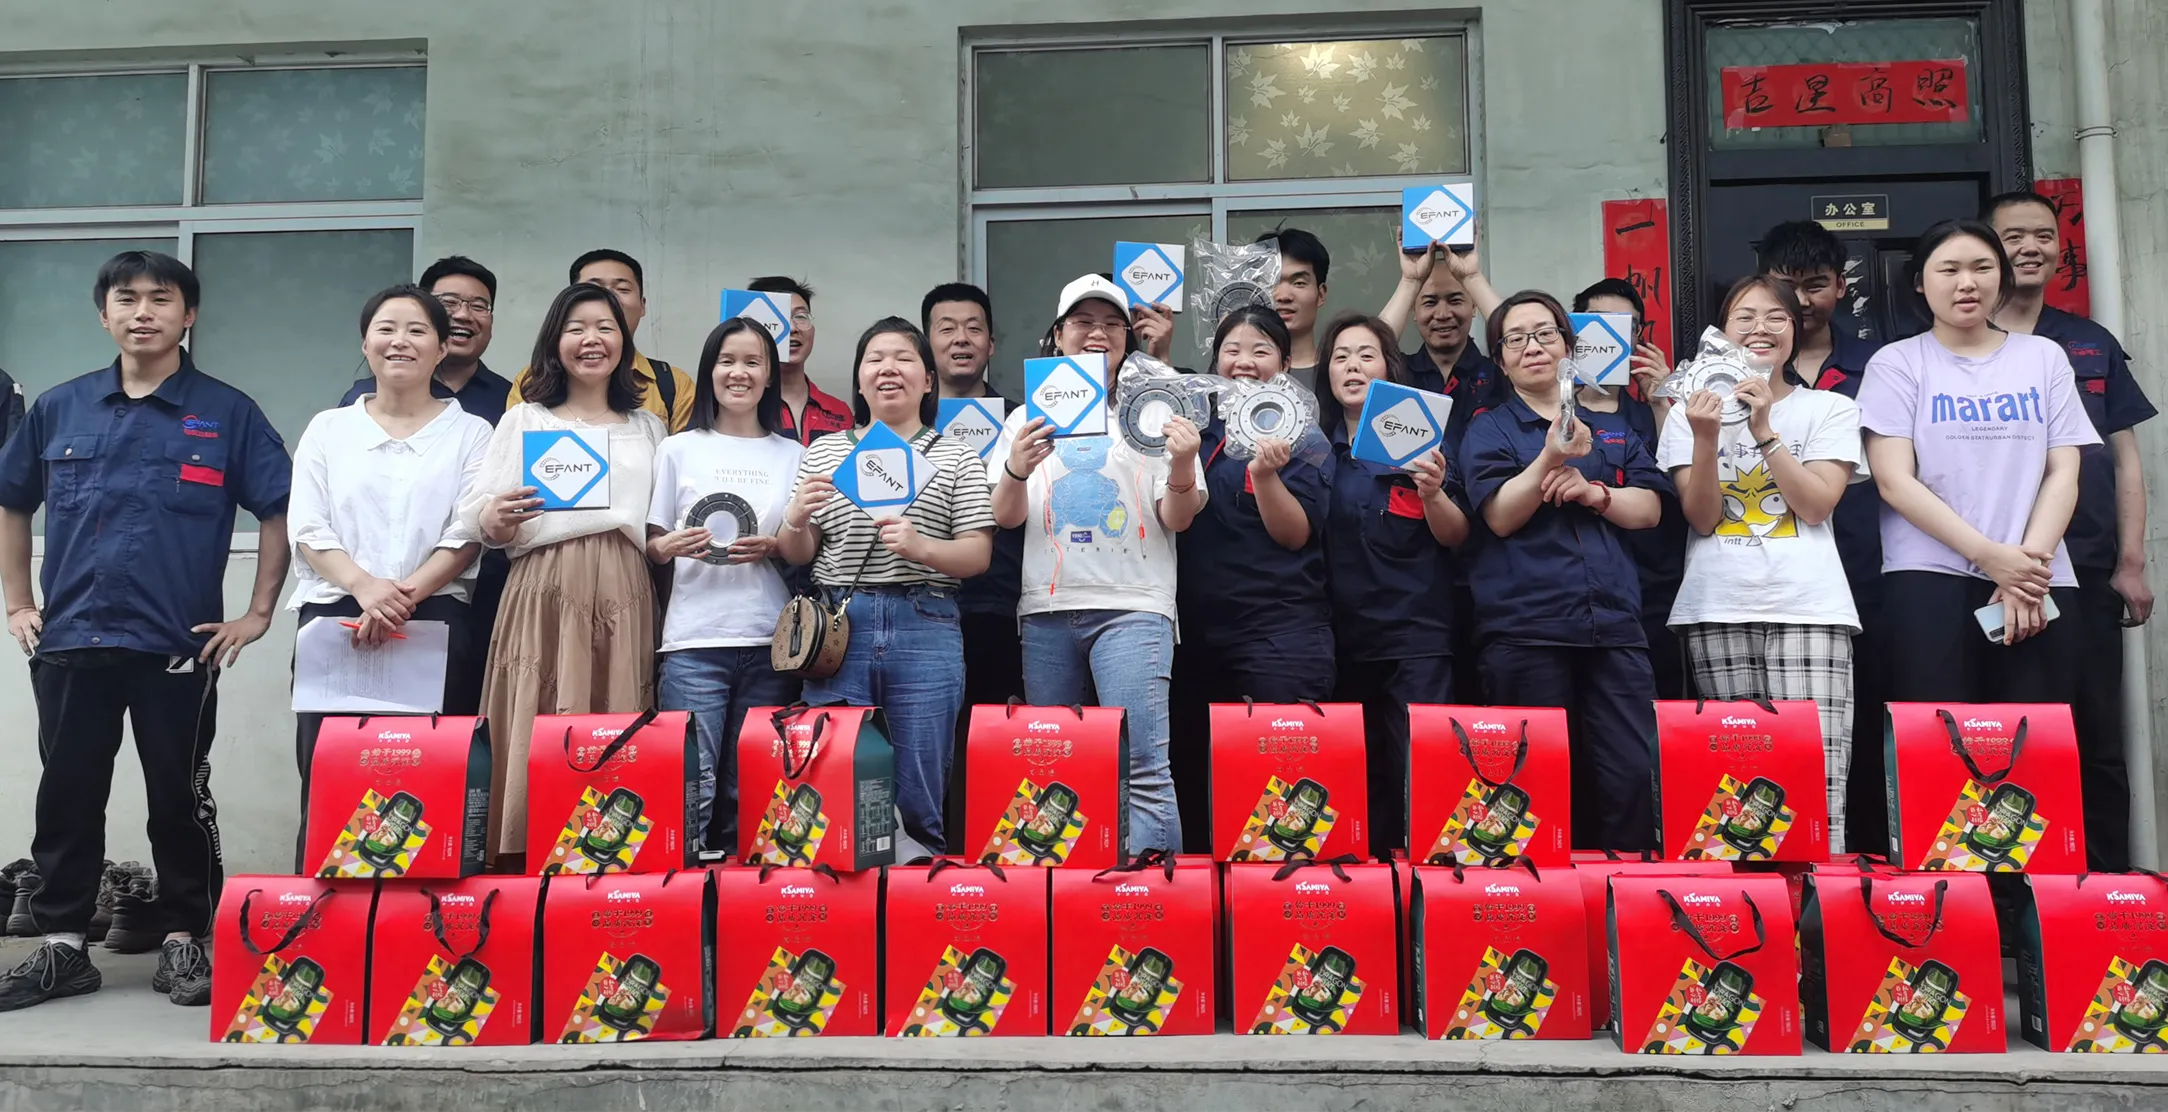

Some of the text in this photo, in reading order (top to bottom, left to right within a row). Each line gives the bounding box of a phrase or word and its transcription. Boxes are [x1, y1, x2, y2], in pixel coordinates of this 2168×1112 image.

[1740, 68, 1957, 114] 吉星高照
[1825, 202, 1876, 216] 办公室
[1575, 345, 1616, 354] EFANT
[1932, 386, 2043, 424] marart
[1383, 420, 1428, 438] EFANT
[545, 463, 592, 473] EFANT
[715, 468, 769, 477] EVERYTHING
[866, 459, 904, 492] EFANT
[1028, 721, 1060, 730] KSAMIYA
[1272, 718, 1304, 727] KSAMIYA
[1473, 721, 1506, 730] KSAMIYA
[1721, 716, 1756, 725] KSAMIYA
[1964, 718, 2003, 728] KSAMIYA
[781, 885, 815, 894] KSAMIYA
[950, 883, 984, 893] KSAMIYA
[1115, 883, 1149, 892] KSAMIYA
[1295, 881, 1330, 891] KSAMIYA
[1485, 883, 1519, 893] KSAMIYA
[441, 893, 475, 902] KSAMIYA
[607, 889, 641, 899] KSAMIYA
[1683, 892, 1721, 903] KSAMIYA
[1888, 891, 1925, 902] KSAMIYA
[2106, 890, 2146, 901] KSAMIYA
